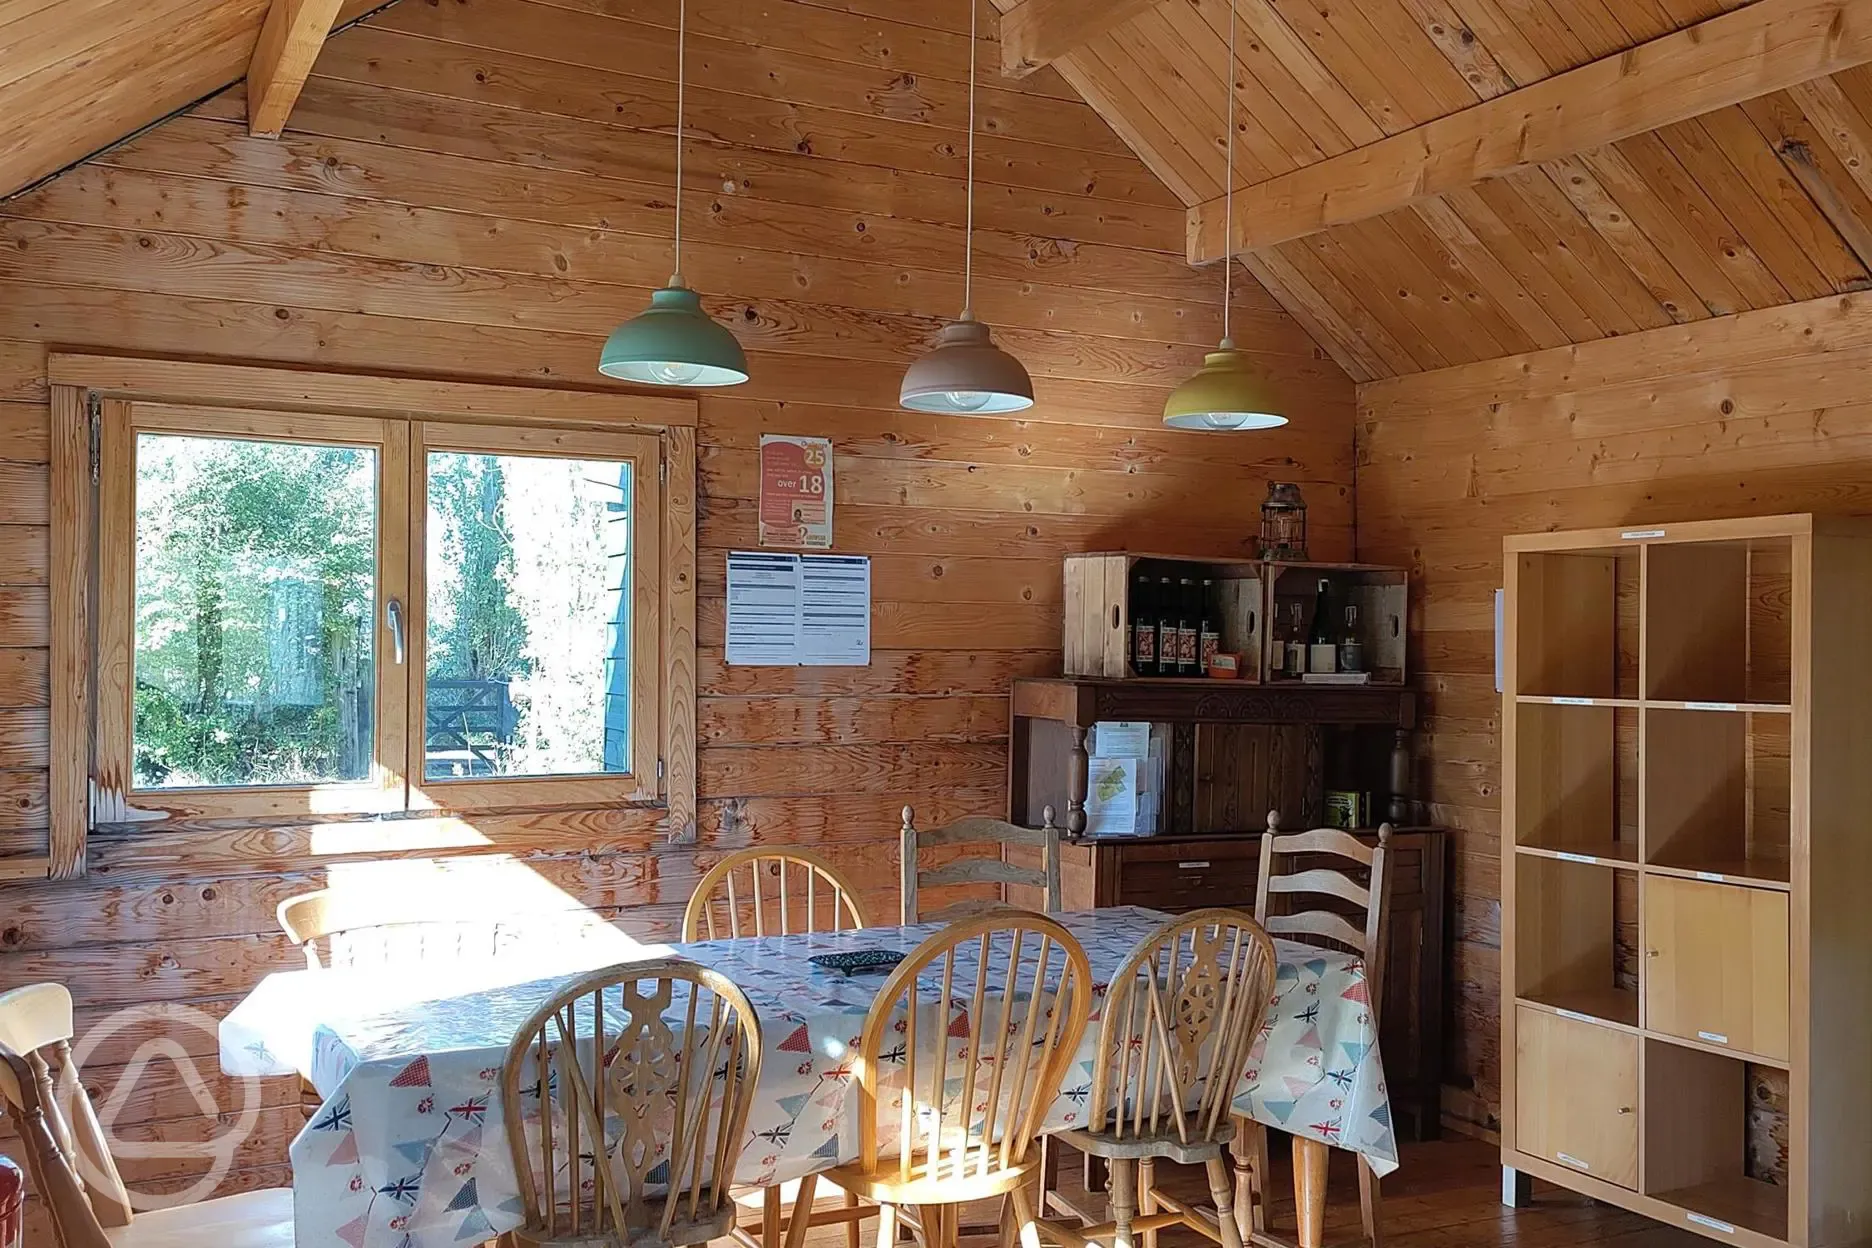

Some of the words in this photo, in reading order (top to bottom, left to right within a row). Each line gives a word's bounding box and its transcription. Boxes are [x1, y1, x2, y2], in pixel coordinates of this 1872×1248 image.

[805, 449, 824, 465] 25
[777, 479, 797, 488] over
[799, 475, 822, 494] 18
